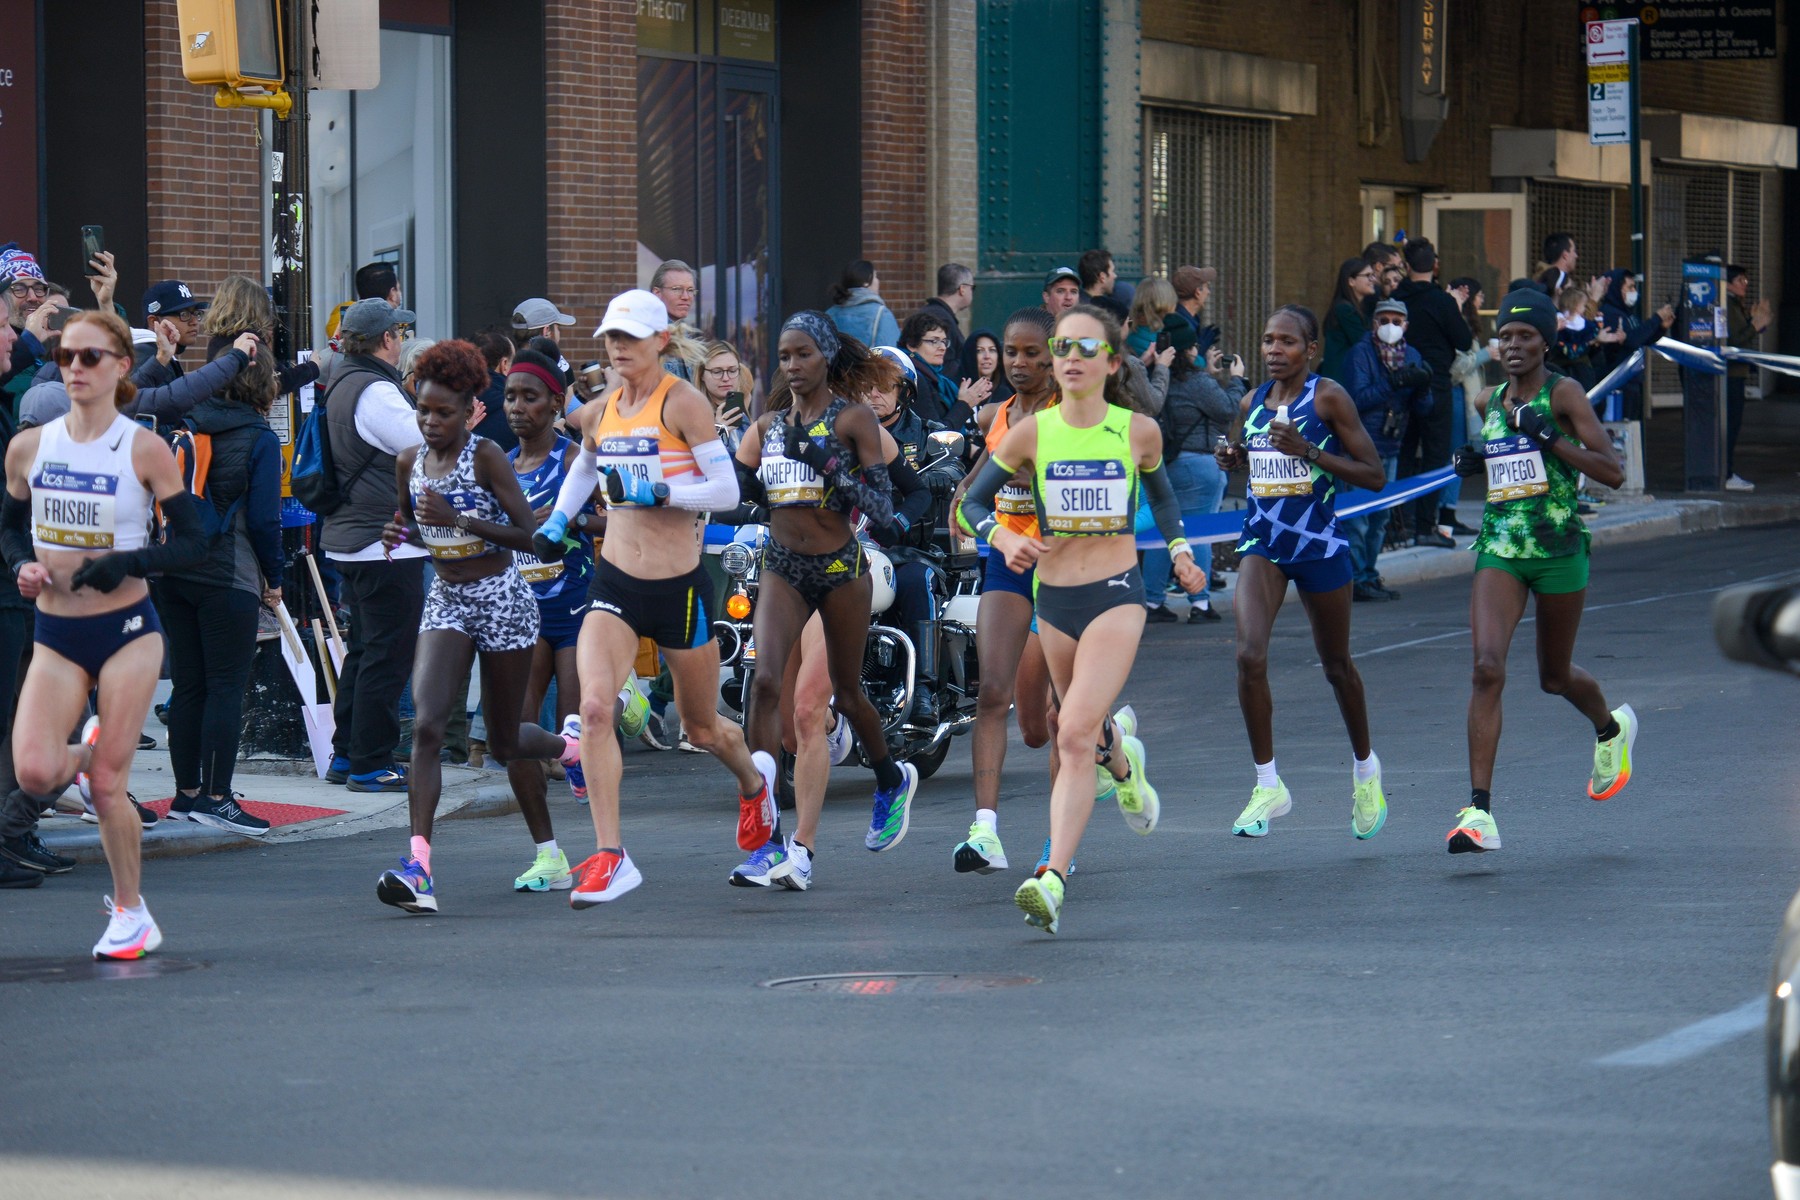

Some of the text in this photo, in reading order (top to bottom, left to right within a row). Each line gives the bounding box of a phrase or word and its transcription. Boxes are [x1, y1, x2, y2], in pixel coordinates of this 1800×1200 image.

[648, 0, 664, 18] THE
[665, 2, 687, 22] CITY
[1659, 7, 1715, 18] Manhattan
[1719, 7, 1726, 17] &
[1731, 7, 1772, 17] Queens
[1650, 30, 1676, 39] Enter
[1679, 30, 1700, 38] with
[1716, 30, 1734, 39] buy
[1421, 0, 1434, 85] SUBWAY
[1650, 39, 1758, 48] MetroCard at all times
[1650, 50, 1660, 58] or
[1664, 50, 1682, 58] see
[1686, 49, 1713, 59] agent
[1716, 49, 1749, 57] across
[1753, 48, 1760, 56] 4
[1593, 83, 1602, 99] 2
[178, 284, 192, 298] NY
[630, 426, 661, 437] HOKA
[1252, 436, 1266, 448] tcs
[1486, 443, 1499, 454] tcs
[1053, 462, 1074, 476] tcs
[1251, 457, 1309, 479] JOHANNES
[1491, 459, 1536, 485] KIPYEGO
[42, 471, 64, 488] tcs
[1061, 487, 1112, 512] SEIDEL
[44, 497, 100, 526] FRISBIE
[1048, 519, 1072, 528] 2021
[37, 527, 58, 540] 2021
